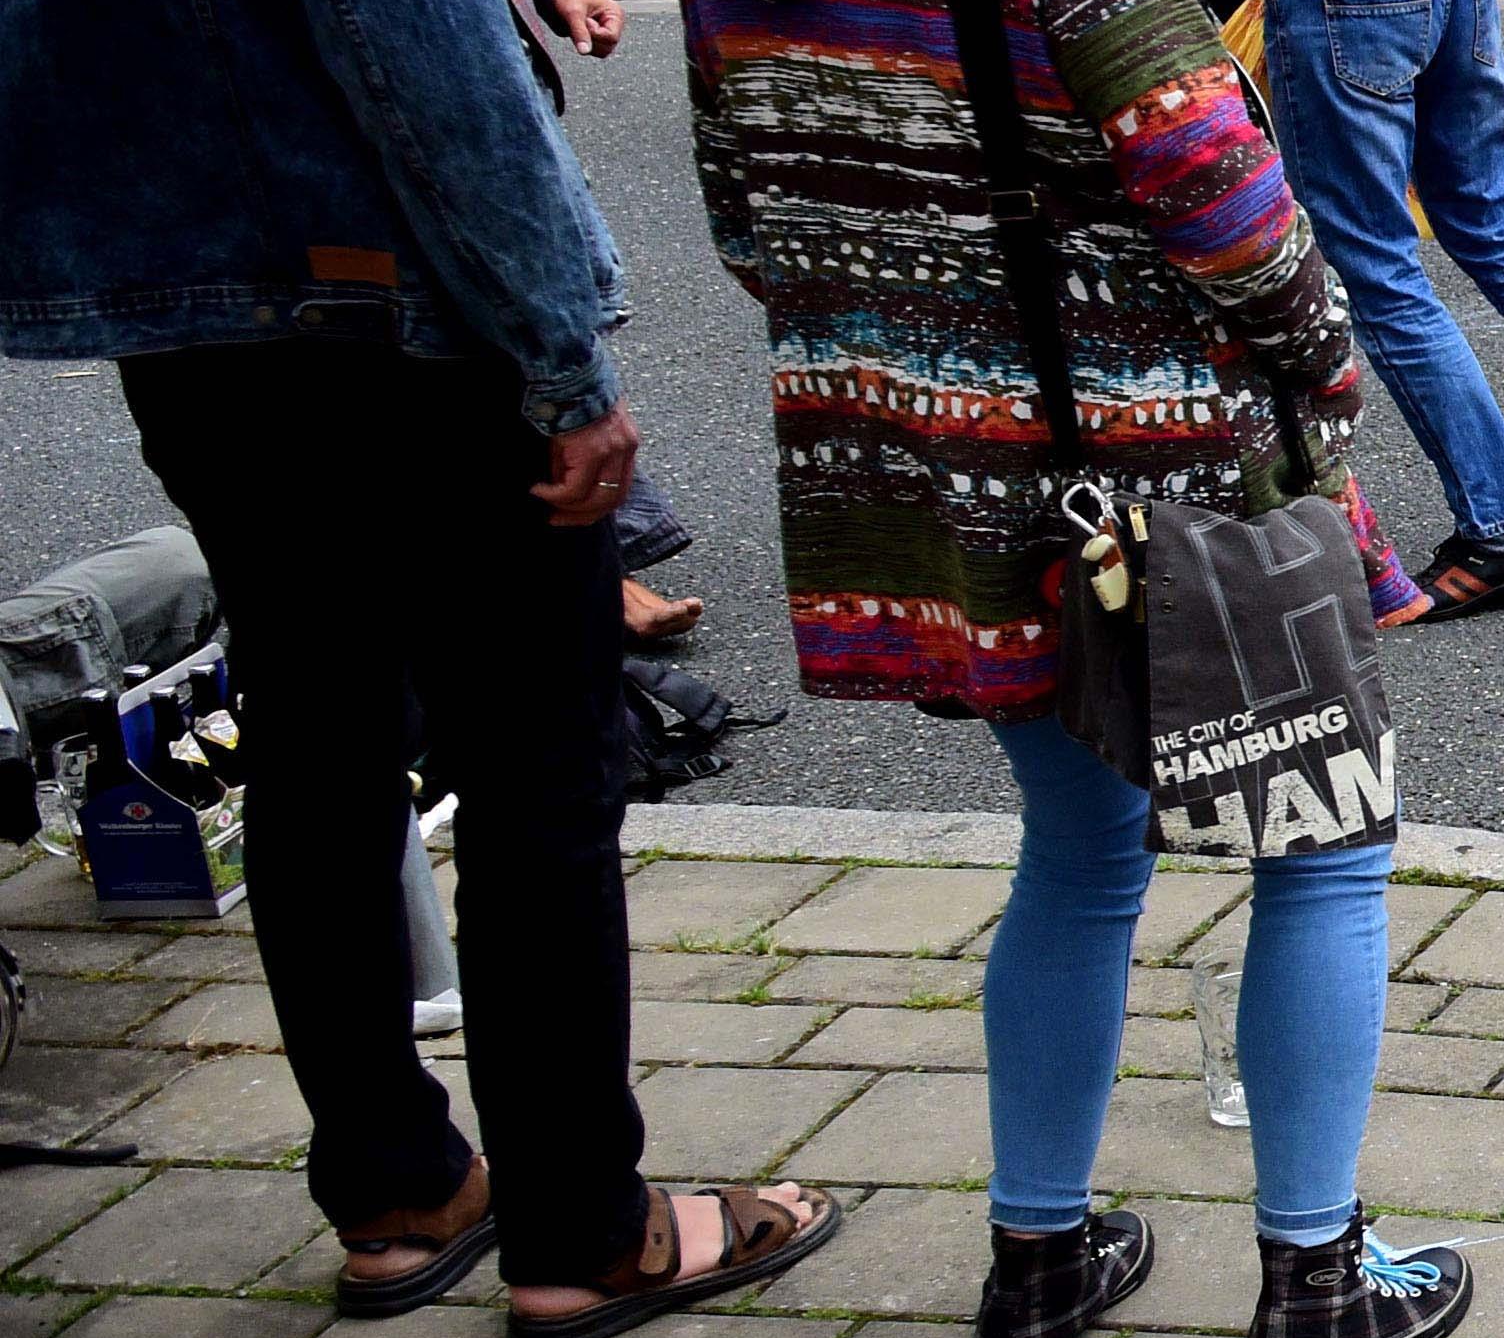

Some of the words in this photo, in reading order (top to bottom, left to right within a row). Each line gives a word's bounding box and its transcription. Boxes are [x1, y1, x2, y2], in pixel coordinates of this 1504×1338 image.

[1151, 730, 1187, 754] THE
[1188, 718, 1228, 744] CITY
[1229, 710, 1257, 732] OF
[1153, 704, 1349, 787] HAMBURG
